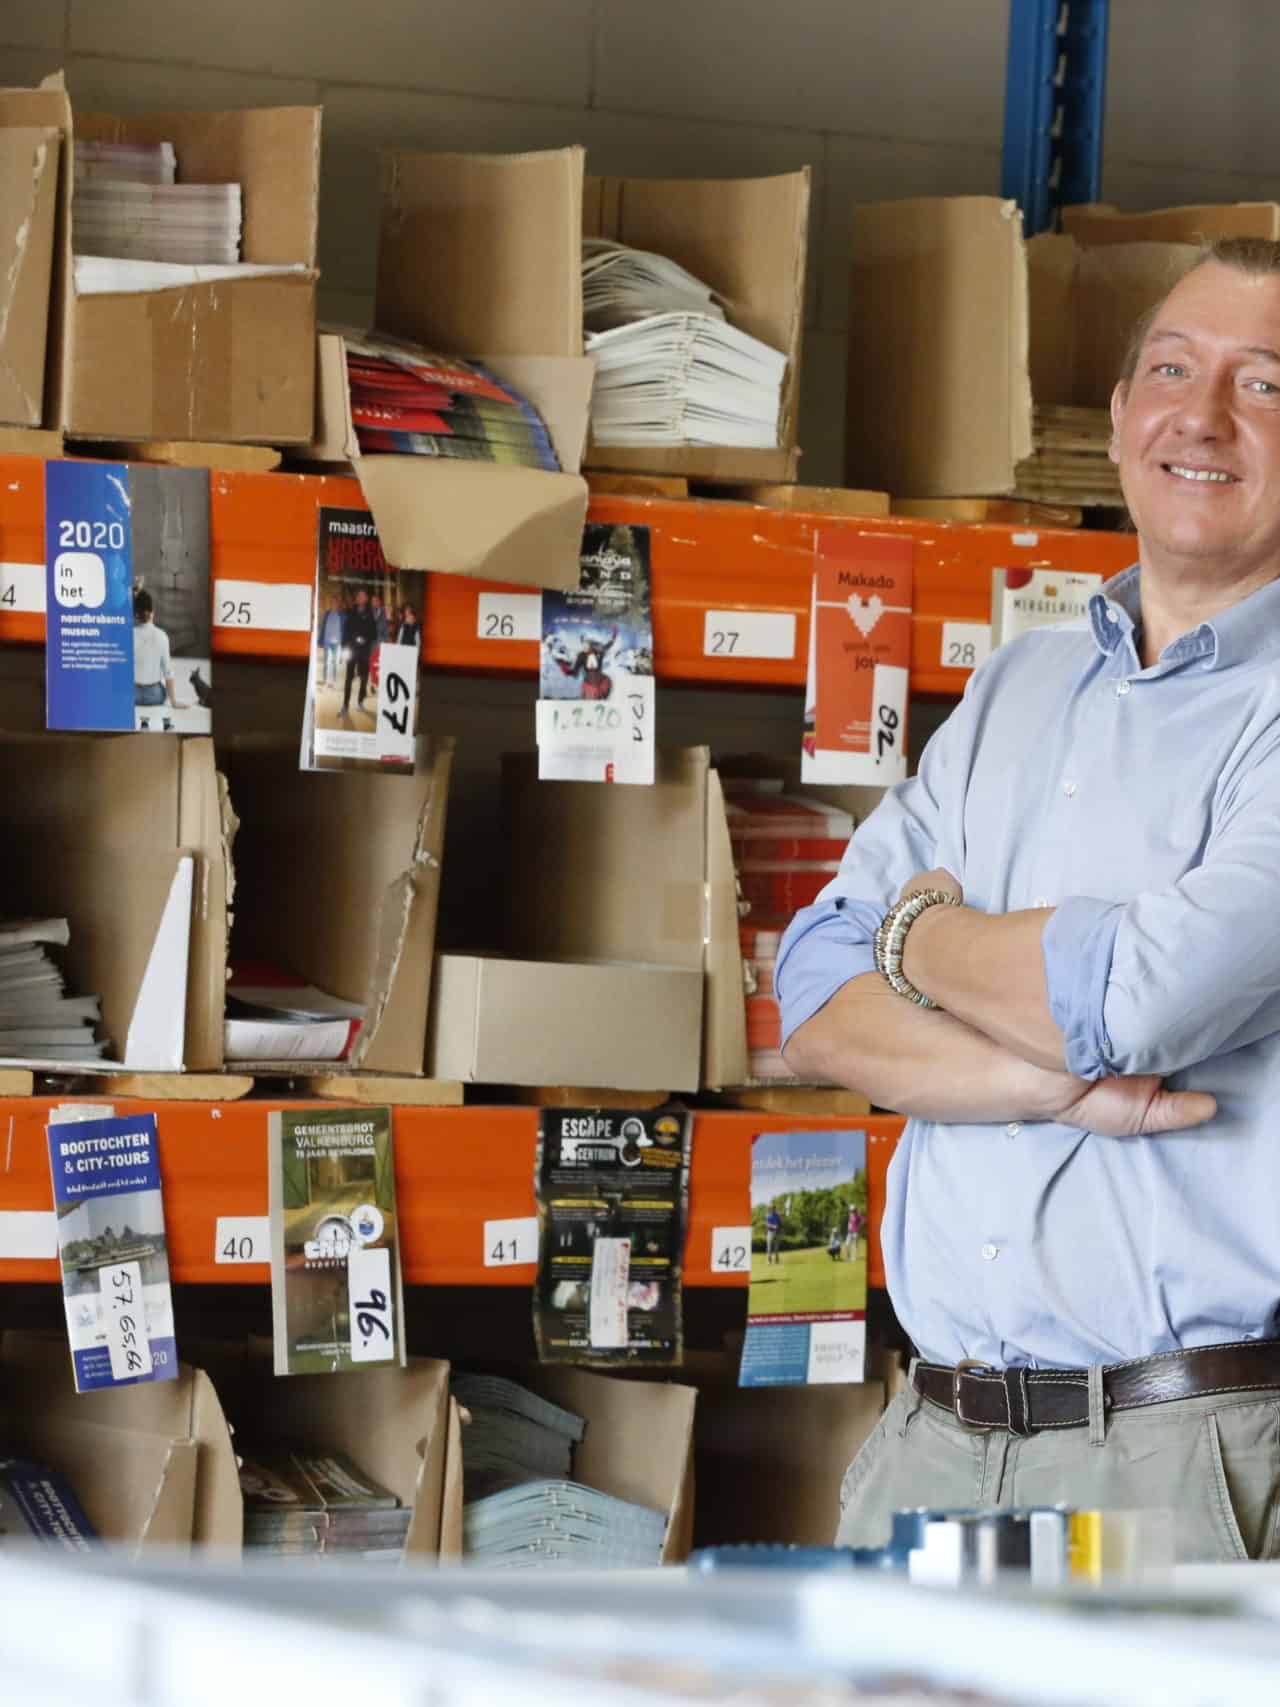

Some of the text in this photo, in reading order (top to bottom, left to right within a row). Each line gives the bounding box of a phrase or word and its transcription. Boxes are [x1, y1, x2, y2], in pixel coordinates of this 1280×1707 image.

[58, 519, 125, 550] 2020
[60, 563, 73, 578] in
[837, 571, 895, 589] Makado
[60, 583, 84, 598] het
[221, 600, 252, 625] 25
[485, 613, 515, 637] 26
[711, 631, 740, 654] 27
[949, 641, 976, 665] 28
[382, 671, 410, 735] 67
[60, 1131, 150, 1156] BOOTTOCHTEN
[295, 1133, 375, 1149] VALKENBURG
[64, 1150, 150, 1175] & CITY-TOURS
[222, 1236, 254, 1260] 40
[491, 1239, 518, 1261] 41
[717, 1245, 747, 1268] 42
